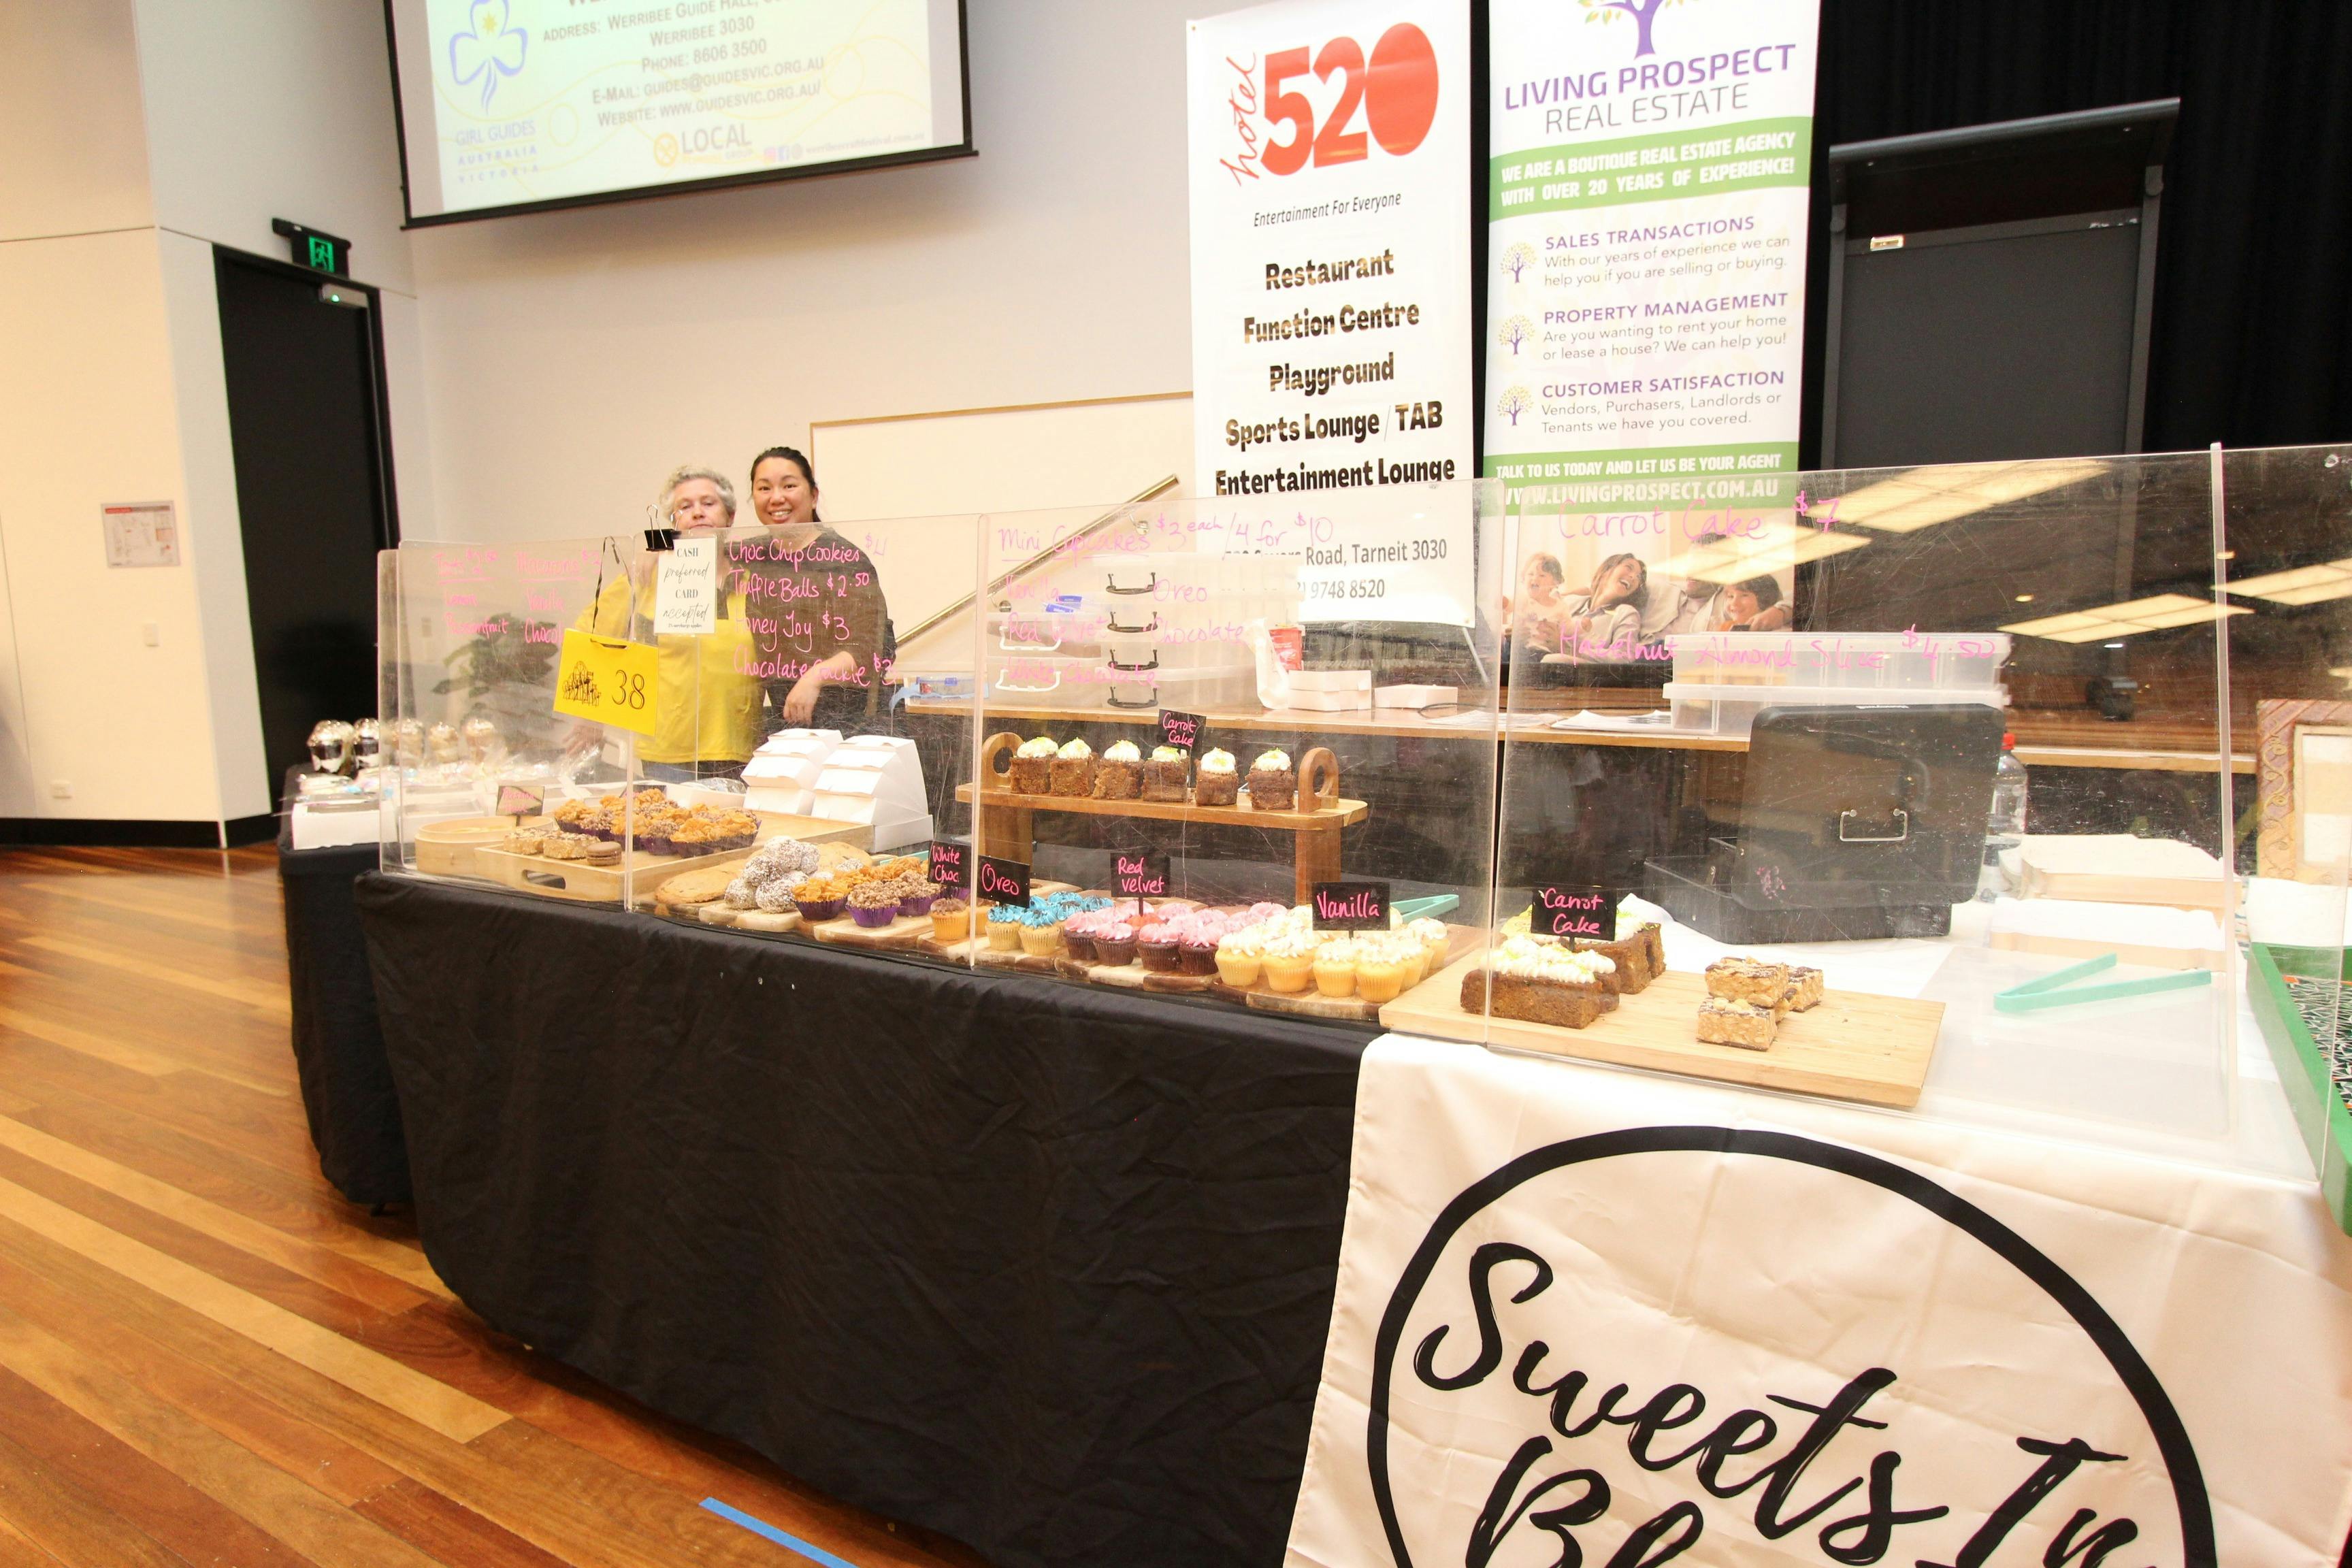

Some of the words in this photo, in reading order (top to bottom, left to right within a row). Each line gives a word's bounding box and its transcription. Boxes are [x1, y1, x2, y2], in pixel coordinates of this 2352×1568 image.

[544, 21, 601, 42] ADDRESS:
[719, 15, 755, 35] 3030
[693, 44, 728, 64] 8606
[732, 38, 767, 60] 3500
[1505, 71, 1607, 110] LIVING
[1618, 44, 1796, 93] PROSPECT
[1260, 22, 1439, 176] 520
[1546, 103, 1621, 134] REAL
[1632, 83, 1749, 122] ESTATE
[488, 120, 536, 141] GUIDES
[1220, 52, 1259, 186] hotel
[682, 123, 752, 154] LOCAL
[1501, 165, 1522, 183] WE
[1524, 161, 1552, 180] ARE
[1554, 159, 1565, 176] A
[1568, 150, 1637, 174] BOUTIQUE
[1640, 145, 1678, 165] REAL
[1681, 138, 1732, 161] ESTATE
[1734, 132, 1796, 155] AGENCY
[1501, 187, 1535, 207] WITH
[1542, 181, 1580, 201] OVER
[1588, 178, 1607, 196] 20
[1616, 172, 1664, 193] YEARS
[1672, 169, 1691, 186] OF
[1700, 157, 1795, 184] EXPERIENCE!
[1254, 201, 1329, 227] Entertainment
[1332, 199, 1350, 216] For
[1352, 192, 1401, 212] Everyone
[1546, 233, 1600, 250] SALES
[1607, 216, 1754, 245] TRANSACTIONS
[1544, 254, 1575, 268] With
[1579, 255, 1599, 266] our
[1605, 251, 1639, 266] years
[1644, 247, 1657, 260] of
[1661, 242, 1736, 263] experience
[1742, 239, 1761, 249] we
[1765, 236, 1790, 248] can
[1266, 248, 1394, 291] Restaurant
[1544, 272, 1572, 287] help
[1575, 274, 1601, 285] you
[1604, 270, 1613, 282] if
[1616, 270, 1640, 282] you
[1644, 267, 1665, 278] are
[1669, 261, 1712, 279] selling
[1716, 261, 1731, 271] or
[1736, 255, 1786, 272] buying.
[1244, 308, 1335, 343] Function
[1339, 301, 1420, 333] Centre
[1544, 305, 1637, 325] PROPERTY
[1645, 293, 1788, 318] MANAGEMENT
[1543, 331, 1566, 342] Are
[1571, 331, 1595, 344] you
[1599, 325, 1654, 342] wanting
[1659, 324, 1673, 335] to
[1678, 322, 1705, 333] rent
[1710, 321, 1740, 336] your
[1746, 315, 1786, 327] home
[1543, 351, 1556, 361] or
[1561, 346, 1595, 359] lease
[1599, 348, 1607, 357] a
[1611, 342, 1660, 356] house?
[1664, 340, 1686, 352] We
[1691, 340, 1716, 350] can
[1720, 334, 1752, 351] help
[1756, 333, 1786, 348] you!
[1269, 352, 1394, 396] Playground
[1542, 379, 1642, 398] CUSTOMER
[1650, 371, 1784, 393] SATISFACTION
[1541, 403, 1601, 416] Vendors,
[1606, 397, 1684, 413] Purchasers,
[1690, 393, 1761, 408] Landlords
[1766, 393, 1781, 404] or
[1226, 415, 1299, 452] Sports
[1305, 410, 1379, 444] Lounge
[1395, 401, 1443, 431] TAB
[1541, 421, 1592, 434] Tenants
[1597, 422, 1617, 431] we
[1622, 417, 1654, 429] have
[1659, 417, 1684, 431] you
[1689, 413, 1751, 427] covered.
[1215, 462, 1373, 496] Entertainment
[1377, 458, 1455, 486] Lounge
[1497, 465, 1524, 479] TALK
[1527, 463, 1542, 478] TO
[1545, 463, 1561, 476] US
[1564, 461, 1603, 476] TODAY
[1606, 459, 1633, 475] AND
[1635, 458, 1656, 474] LET
[1660, 457, 1676, 472] US
[1680, 456, 1695, 472] BE
[1699, 455, 1734, 471] YOUR
[1737, 453, 1782, 469] AGENT
[1559, 499, 1666, 539] Carrot
[1683, 499, 1769, 540] Cake
[1793, 490, 1840, 533] $7
[676, 547, 698, 557] CASH
[730, 536, 765, 562] Choc
[770, 538, 804, 572] Chip
[807, 538, 860, 563] Cookies
[998, 527, 1040, 551] Mini
[1053, 525, 1151, 568] Cupcakes
[1256, 521, 1288, 546] for
[1294, 512, 1333, 546] $10
[1307, 544, 1347, 566] Road,
[1352, 541, 1407, 564] Tarneit
[1412, 538, 1447, 561] 3030
[664, 561, 710, 584] preferred
[730, 568, 777, 604] Truffle
[779, 578, 819, 602] Balls
[675, 589, 698, 599] CARD
[1153, 578, 1208, 603] Oreo
[1310, 581, 1345, 600] 9748
[1350, 578, 1385, 598] 8520
[663, 602, 709, 623] accepted
[1008, 612, 1042, 642] Red
[1149, 616, 1245, 644] Chocolate
[736, 615, 777, 652] Honey
[783, 611, 812, 652] Joy
[823, 611, 849, 640] $3
[1560, 621, 1679, 669] Hazelnut
[1694, 637, 1797, 666] Almond
[1811, 637, 1885, 670] Slice
[734, 644, 807, 678] Chocolate
[612, 670, 644, 710] 38
[1162, 712, 1196, 734] Carrot
[1169, 731, 1194, 747] Cake
[932, 845, 960, 864] White
[1118, 857, 1144, 876] Red
[935, 864, 959, 883] Choc
[982, 864, 1019, 895] Oreo
[1317, 891, 1379, 919] Vanilla
[1544, 887, 1604, 911] Carrot
[1553, 913, 1601, 934] Cake
[1413, 1242, 1948, 1565] Sweets
